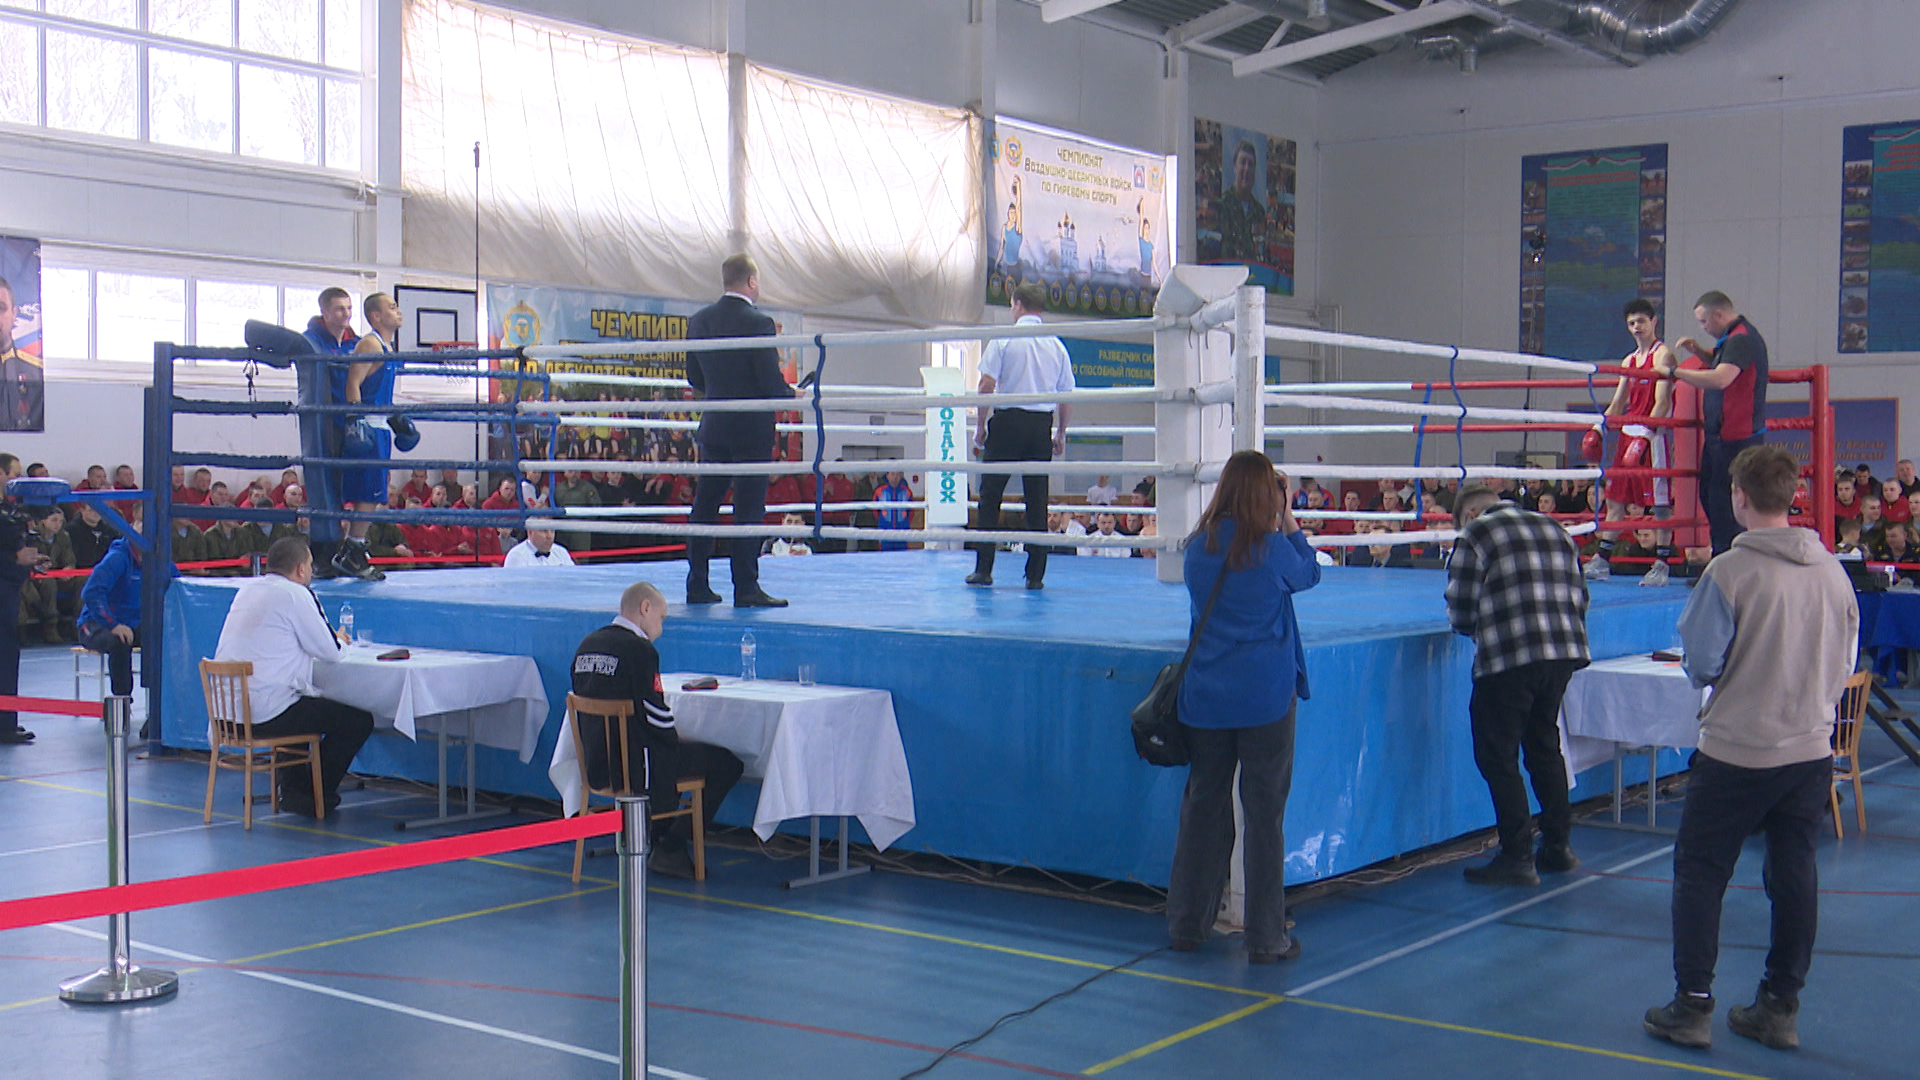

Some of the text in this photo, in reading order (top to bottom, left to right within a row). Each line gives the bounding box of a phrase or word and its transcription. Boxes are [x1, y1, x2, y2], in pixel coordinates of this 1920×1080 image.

[1057, 147, 1104, 169] ЧЕМПИОНАТ
[1092, 189, 1118, 206] СПОРТУ
[940, 393, 955, 462] OTAL
